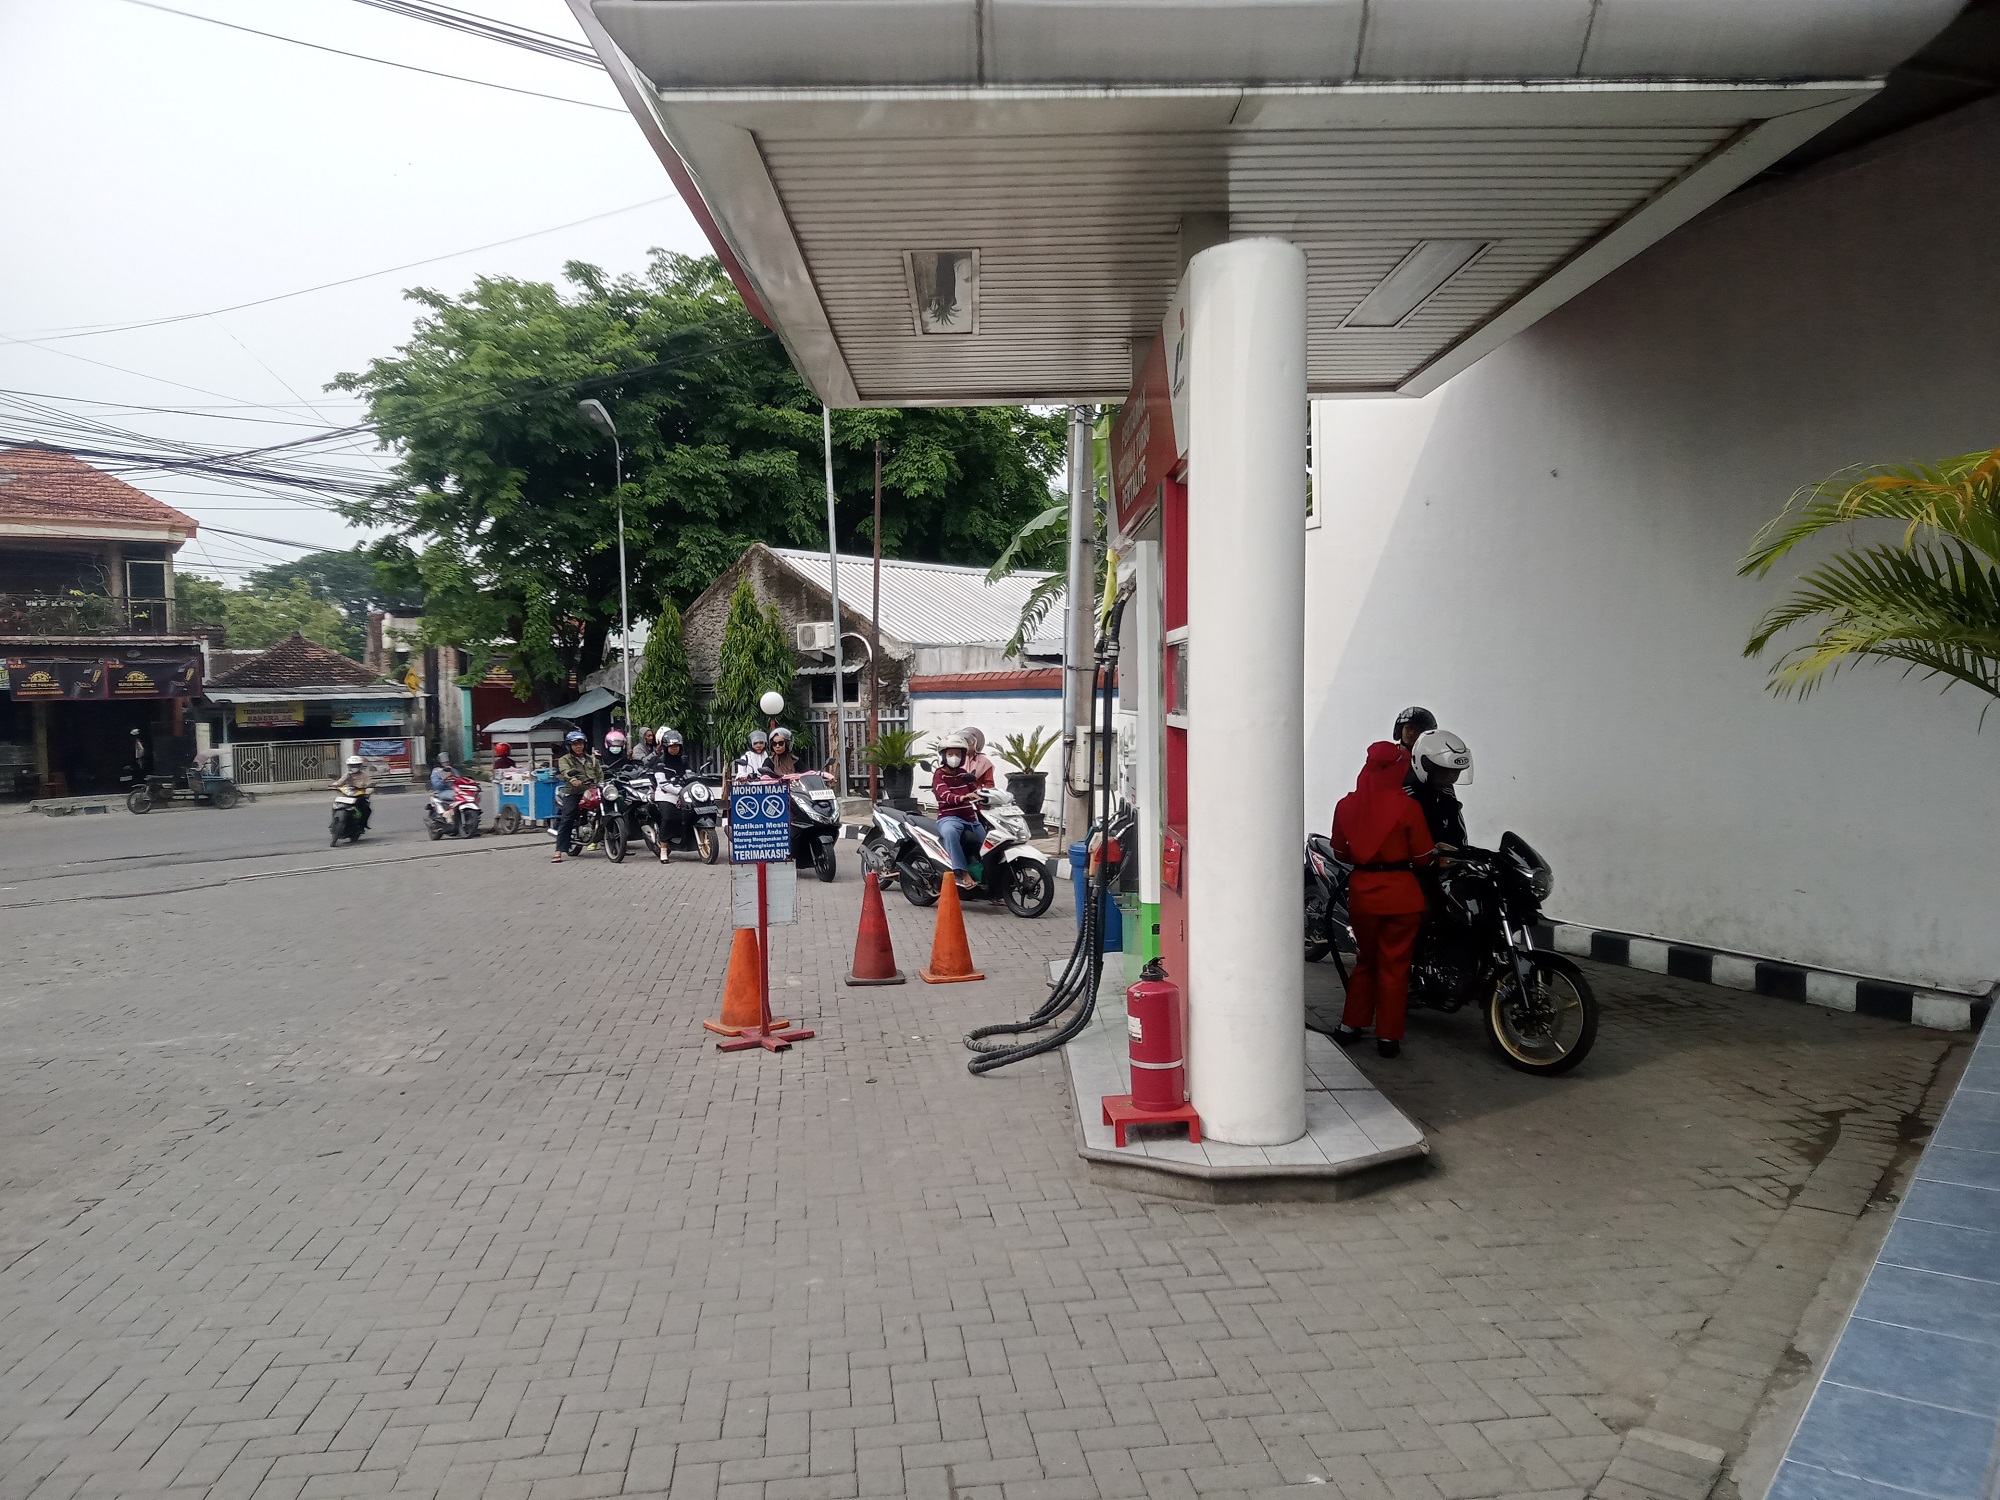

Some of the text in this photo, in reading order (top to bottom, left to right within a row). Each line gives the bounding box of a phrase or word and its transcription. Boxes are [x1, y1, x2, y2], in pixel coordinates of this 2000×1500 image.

[1121, 453, 1147, 515] PERTALITE
[732, 785, 787, 795] MOHON MAAF
[734, 848, 790, 860] TERIMAKASIH
